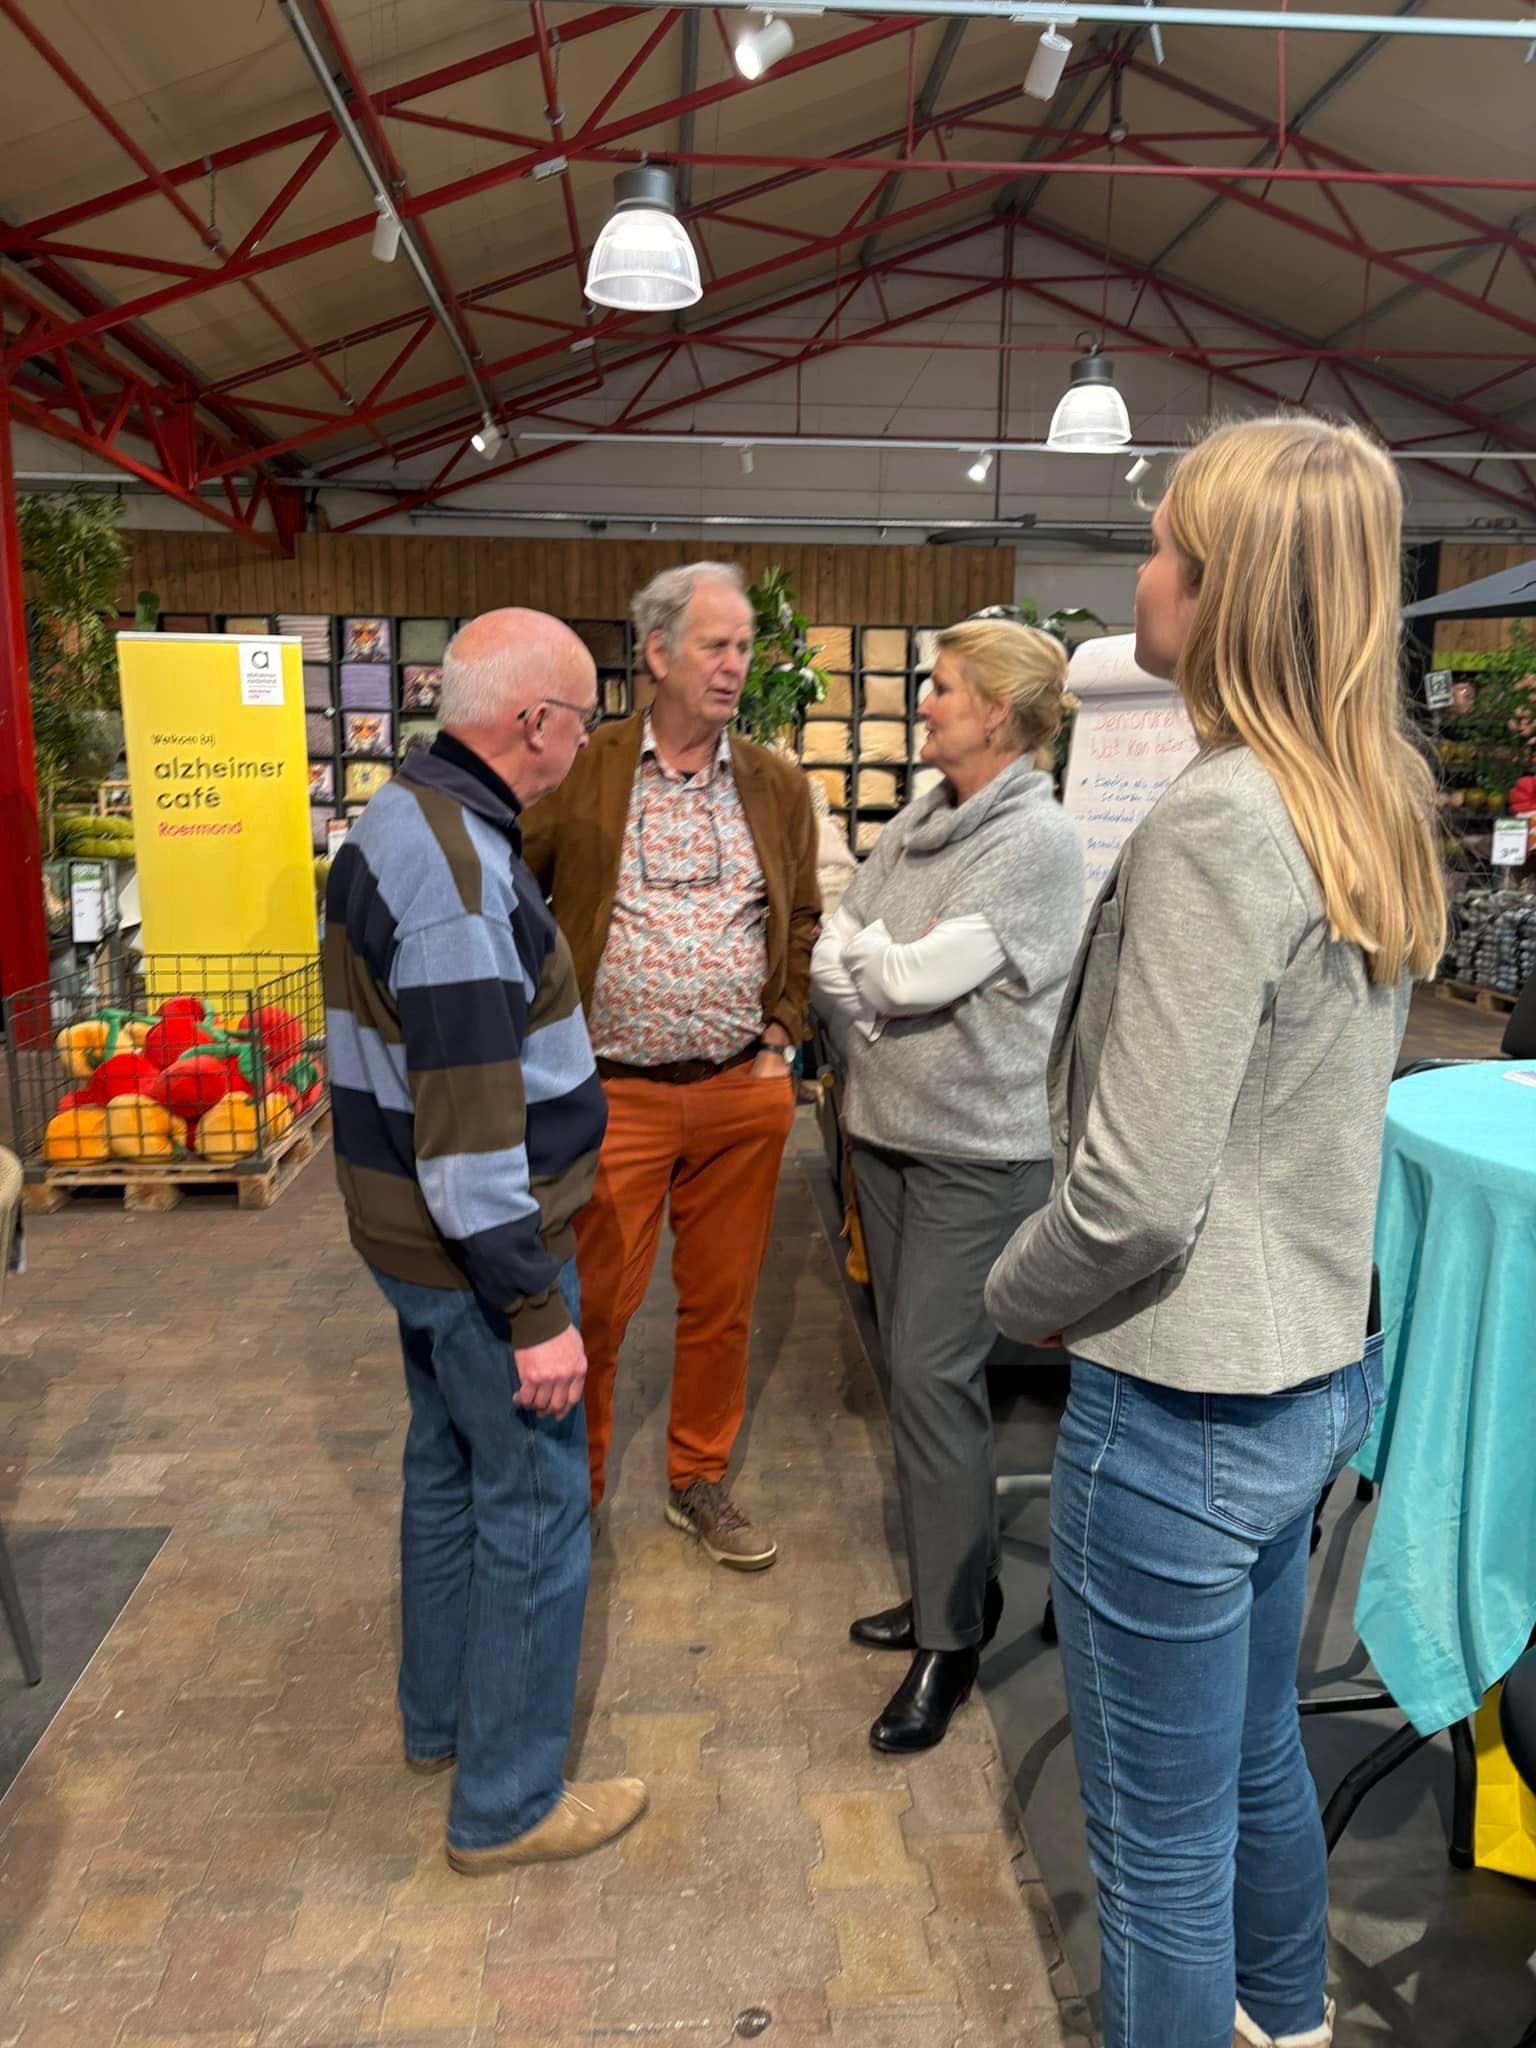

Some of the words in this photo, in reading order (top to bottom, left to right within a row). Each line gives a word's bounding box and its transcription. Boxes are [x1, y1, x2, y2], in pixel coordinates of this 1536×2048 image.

[154, 756, 285, 779] alzheimer
[156, 785, 221, 810] café
[159, 818, 243, 837] Roermond
